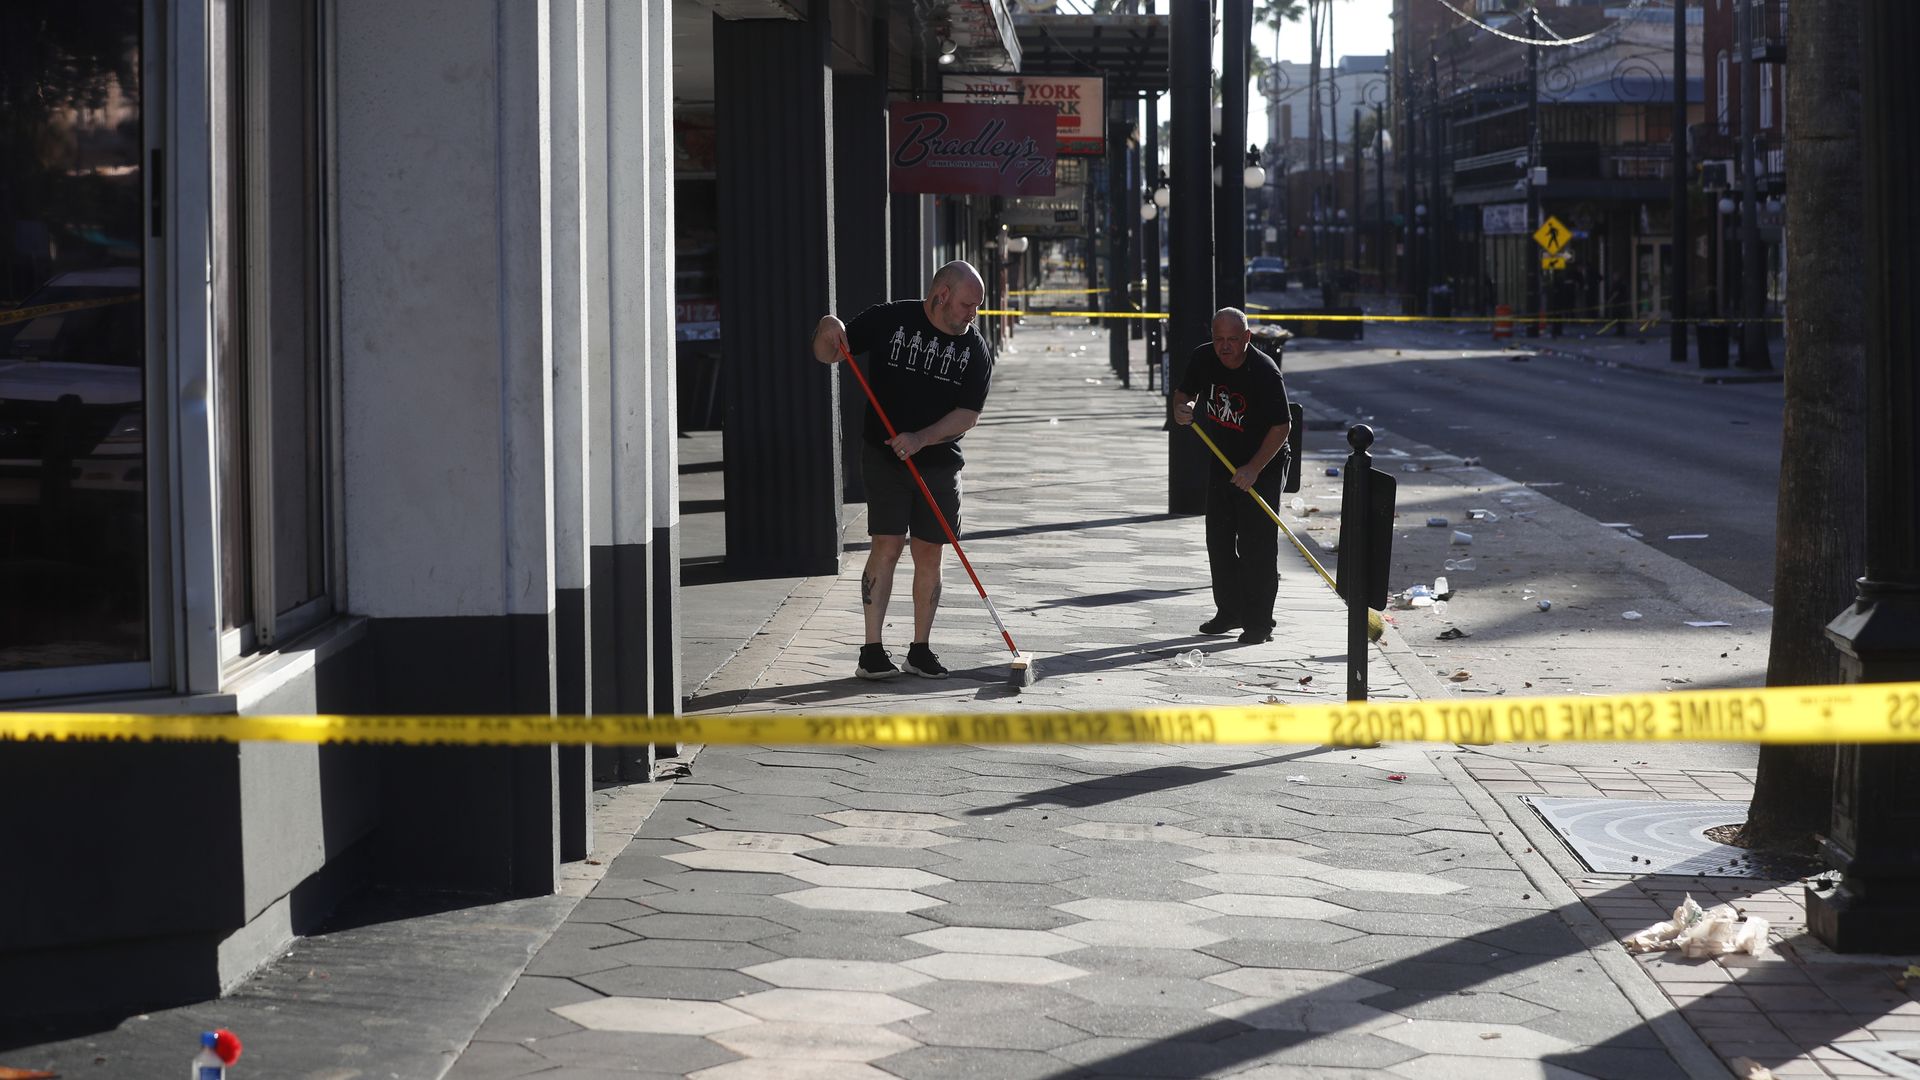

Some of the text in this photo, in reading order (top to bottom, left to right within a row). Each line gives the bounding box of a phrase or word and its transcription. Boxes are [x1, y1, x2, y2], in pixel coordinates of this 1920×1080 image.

[964, 83, 1080, 100] NEW YORK
[892, 111, 1039, 174] Bradley's
[676, 303, 721, 321] PIZZ
[1208, 383, 1217, 400] I
